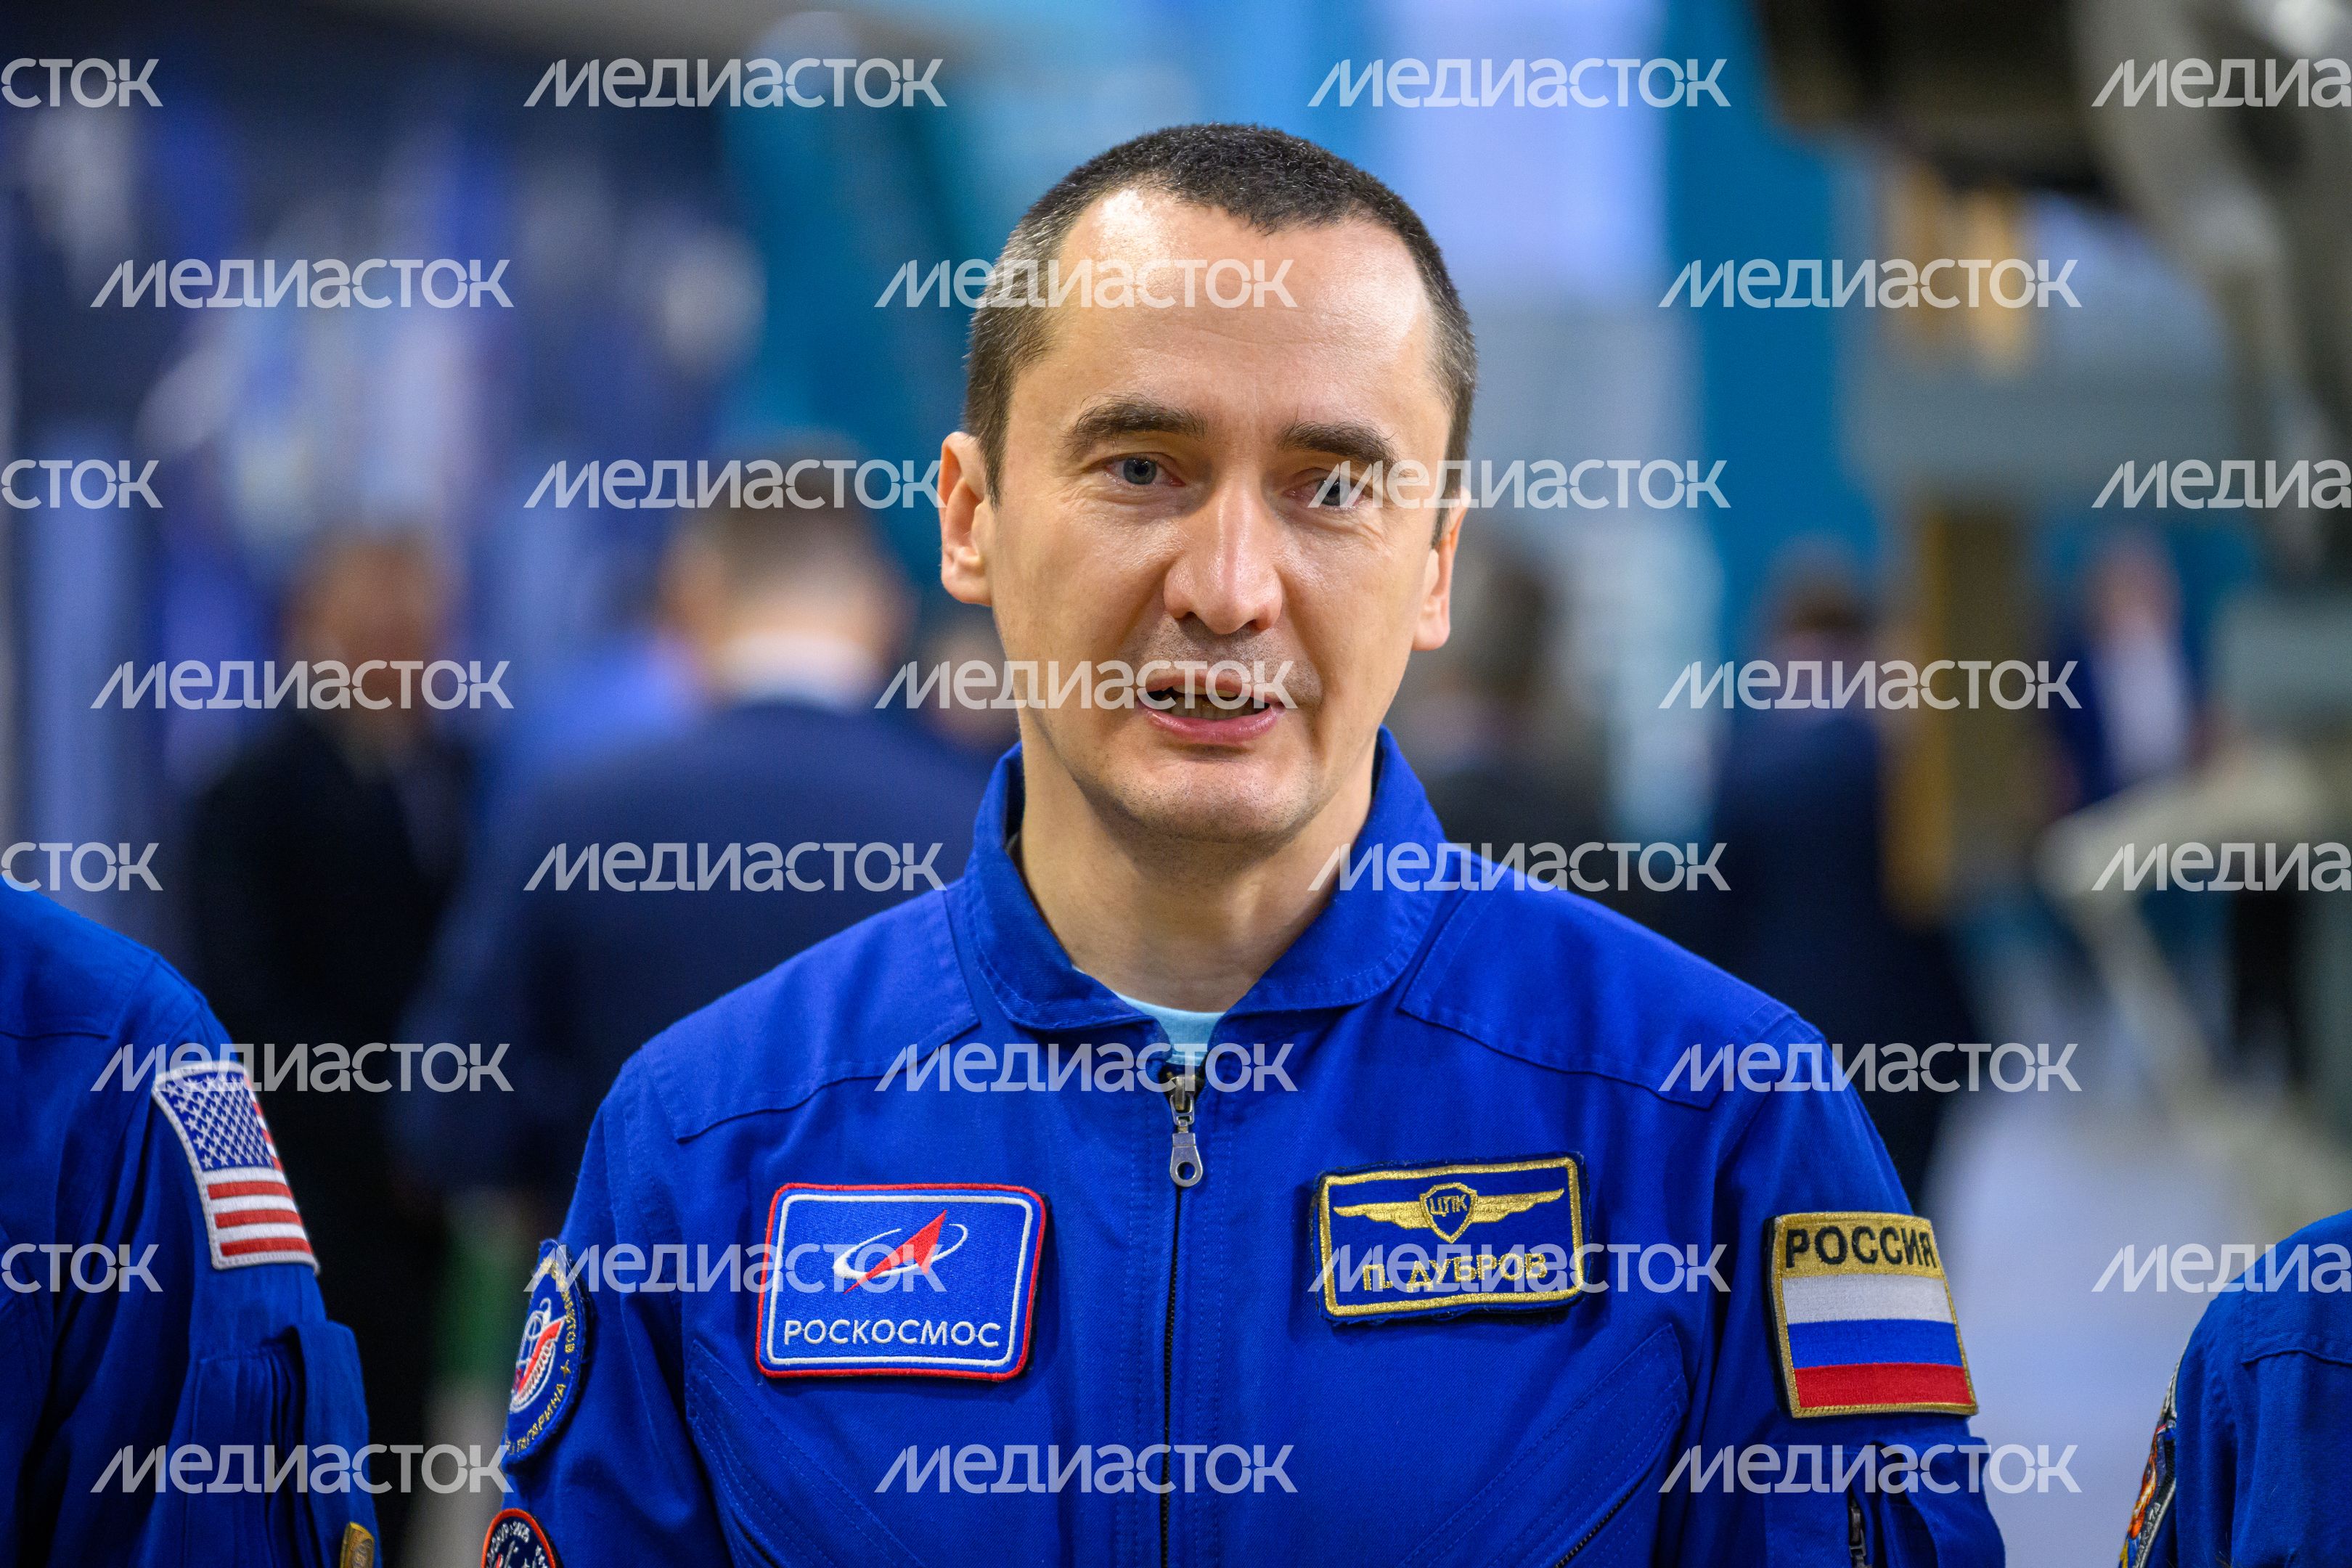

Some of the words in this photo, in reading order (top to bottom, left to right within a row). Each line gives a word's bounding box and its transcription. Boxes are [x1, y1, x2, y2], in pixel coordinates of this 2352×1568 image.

[1426, 1193, 1470, 1218] ЦПК
[1786, 1225, 1937, 1269] РОССИЯ
[1363, 1264, 1393, 1291] П.
[1406, 1253, 1548, 1293] ДУБРОВ
[784, 1318, 1002, 1349] РОСКОСМОС
